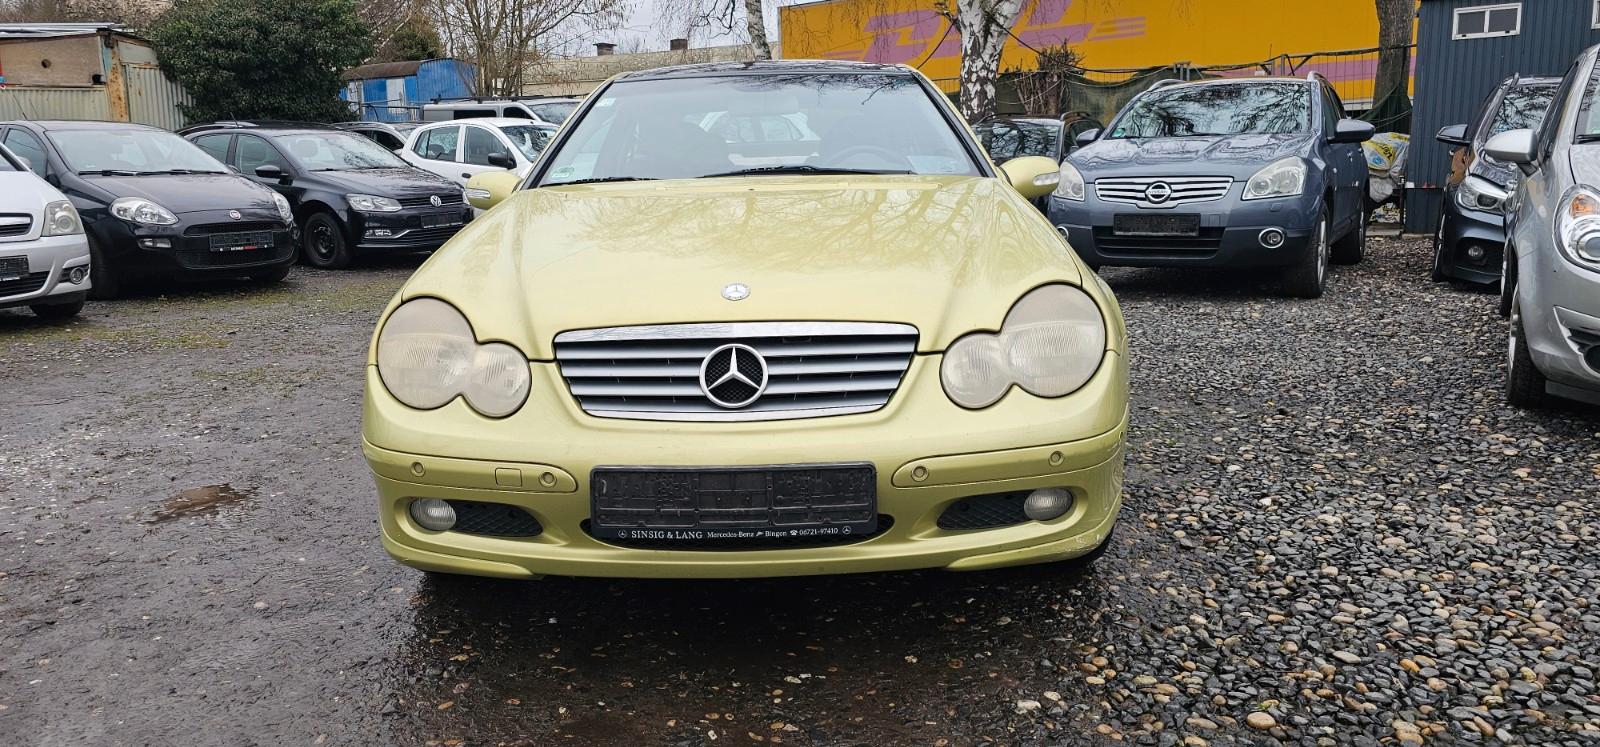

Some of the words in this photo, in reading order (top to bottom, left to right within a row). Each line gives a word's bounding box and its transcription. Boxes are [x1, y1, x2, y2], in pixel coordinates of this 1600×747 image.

[863, 0, 1093, 63] DL
[631, 530, 665, 539] SINSIG
[666, 531, 674, 539] &
[675, 531, 703, 539] LANG
[707, 530, 755, 538] Mercedes-Benz
[765, 530, 787, 538] Bingen
